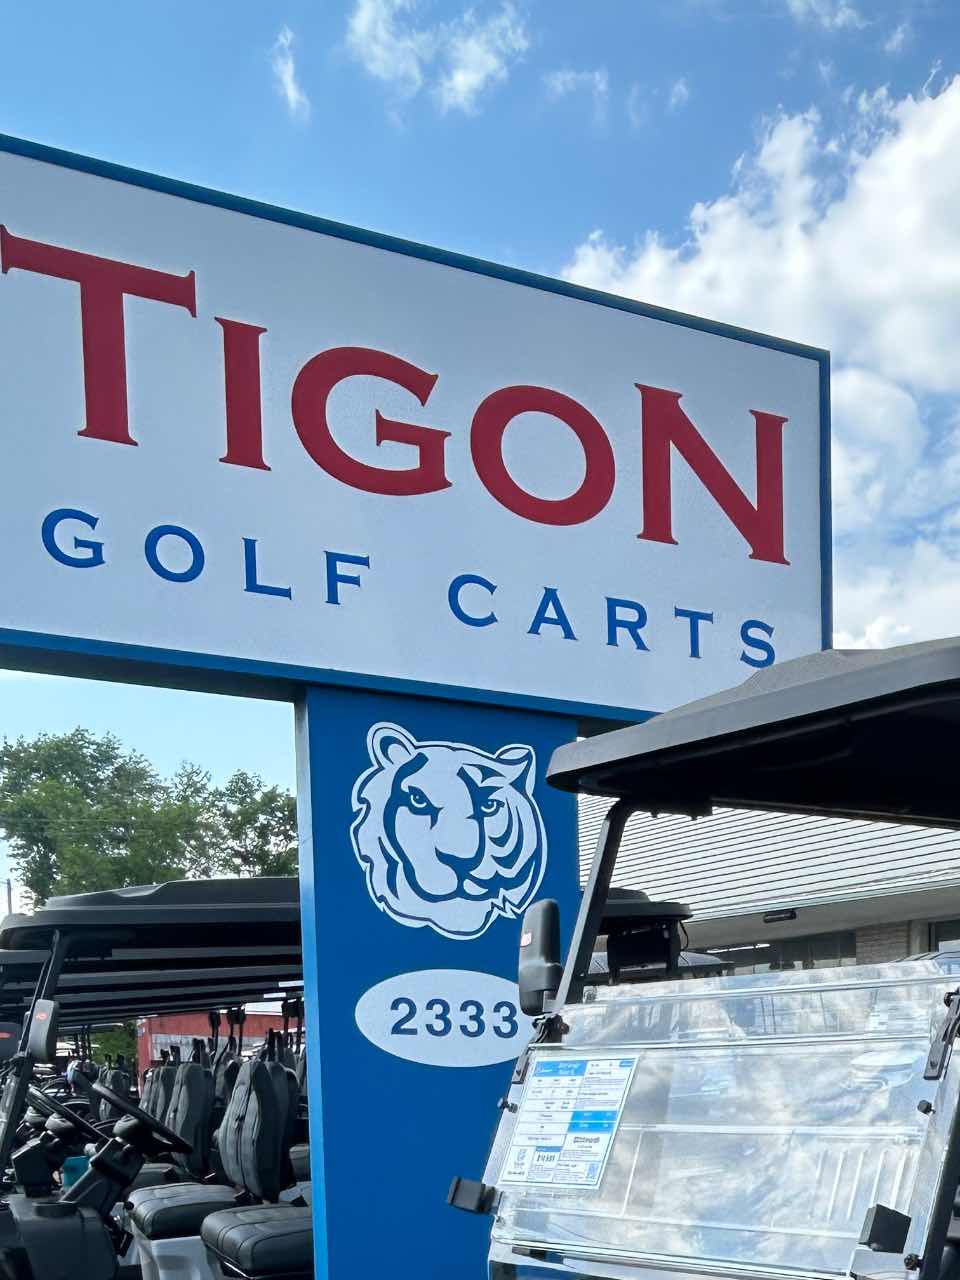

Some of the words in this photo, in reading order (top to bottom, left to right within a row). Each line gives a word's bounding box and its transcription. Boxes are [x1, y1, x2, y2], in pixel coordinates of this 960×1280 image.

[1, 224, 791, 566] TIGON
[41, 508, 371, 605] GOLF
[448, 573, 777, 669] CARTS
[390, 997, 519, 1039] 2333
